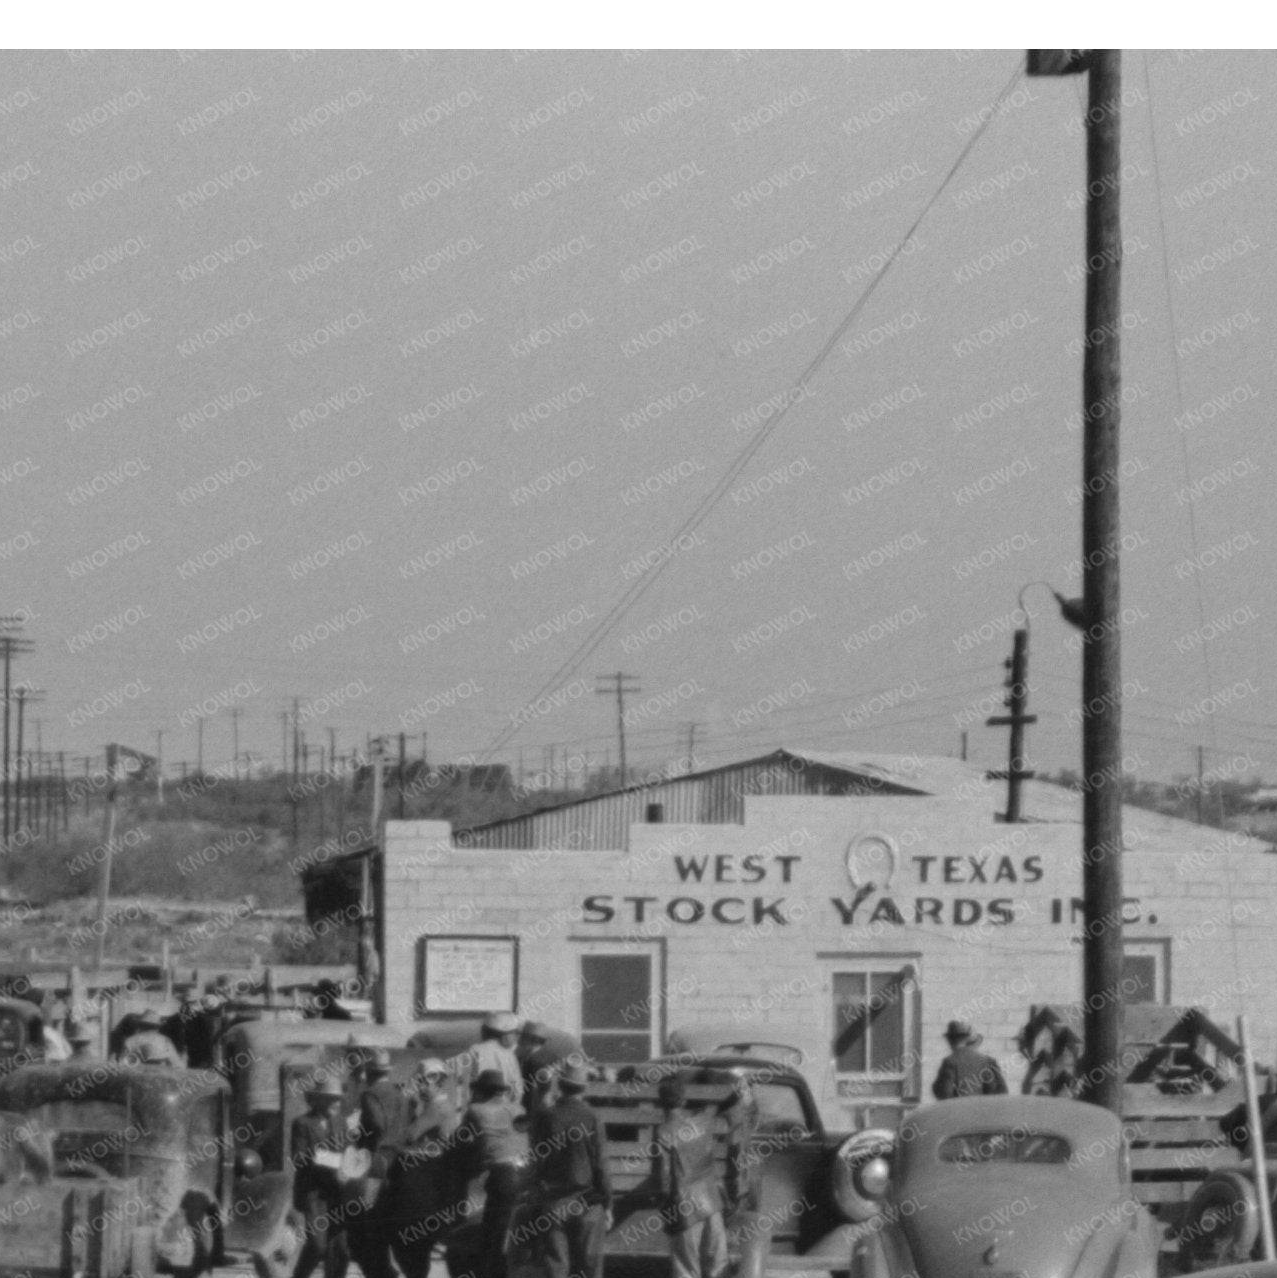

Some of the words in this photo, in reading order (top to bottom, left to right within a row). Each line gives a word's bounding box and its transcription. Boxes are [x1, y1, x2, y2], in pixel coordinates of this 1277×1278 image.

[674, 855, 802, 883] WEST
[911, 855, 1044, 884] TEXAS
[583, 895, 788, 925] STOCK
[829, 881, 1015, 926] YARDS
